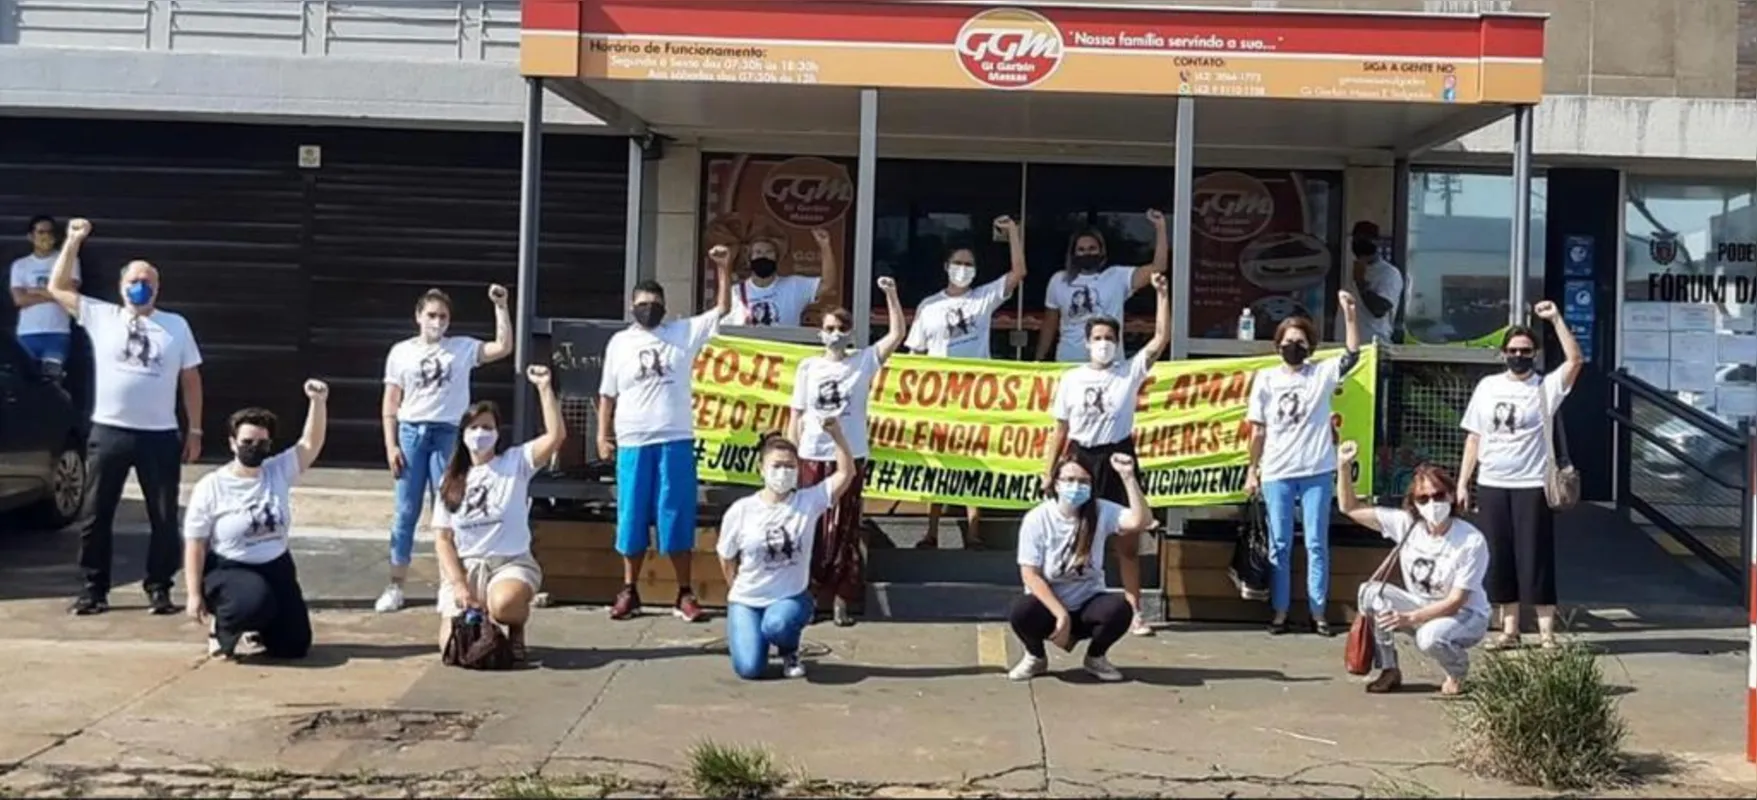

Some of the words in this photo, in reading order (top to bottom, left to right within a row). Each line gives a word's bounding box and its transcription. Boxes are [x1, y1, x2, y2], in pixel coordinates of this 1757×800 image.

[644, 41, 660, 54] de
[956, 27, 1061, 61] GGM
[1226, 40, 1238, 50] a
[1362, 61, 1388, 72] SIGA
[1390, 63, 1400, 72] A
[1401, 63, 1434, 74] GENTE
[1648, 269, 1729, 304] FÓRUM
[692, 347, 784, 391] HOJE
[895, 369, 1022, 411] SOMOS
[866, 416, 990, 456] IOLENCIA
[999, 425, 1056, 459] CON
[877, 460, 1047, 503] #NENHUMAAMEN
